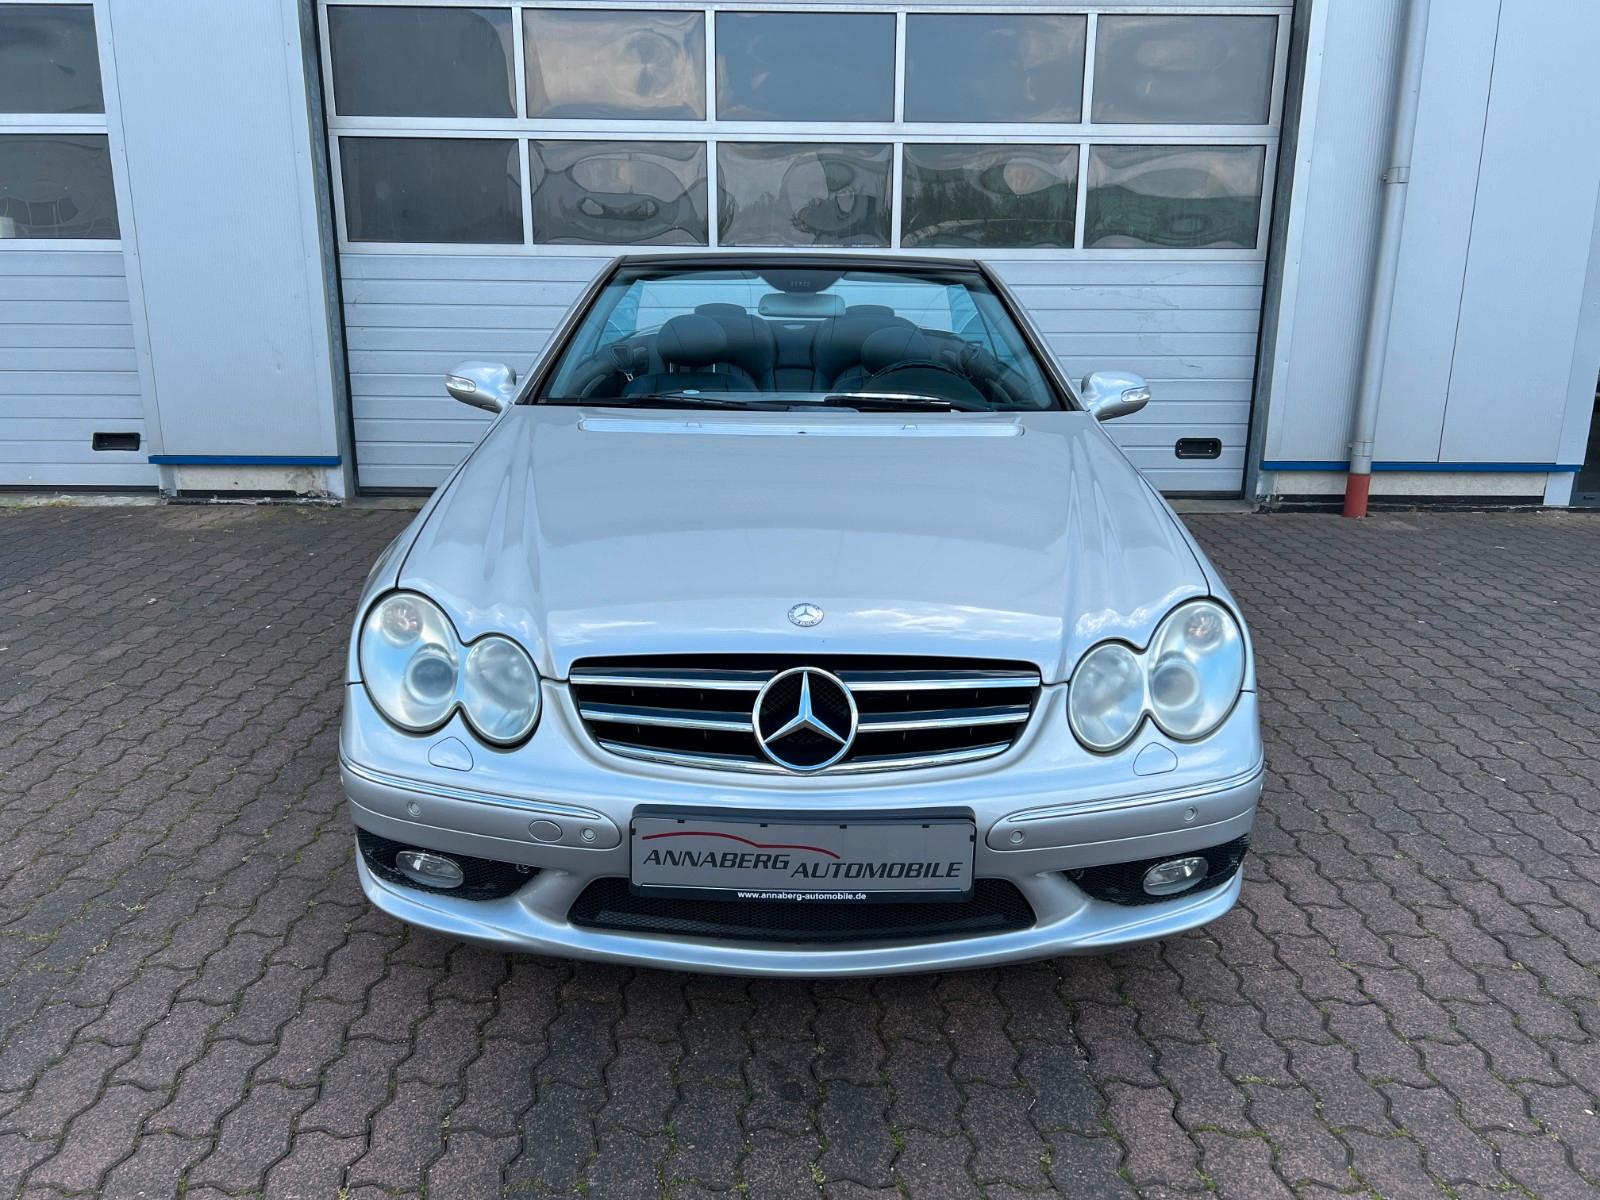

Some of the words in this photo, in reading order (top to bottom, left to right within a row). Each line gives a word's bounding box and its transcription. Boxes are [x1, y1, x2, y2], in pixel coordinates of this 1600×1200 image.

[642, 849, 791, 871] ANNABERG
[790, 861, 963, 879] AUTOMOBILE
[737, 890, 867, 901] www.annaberg-automobile.de
